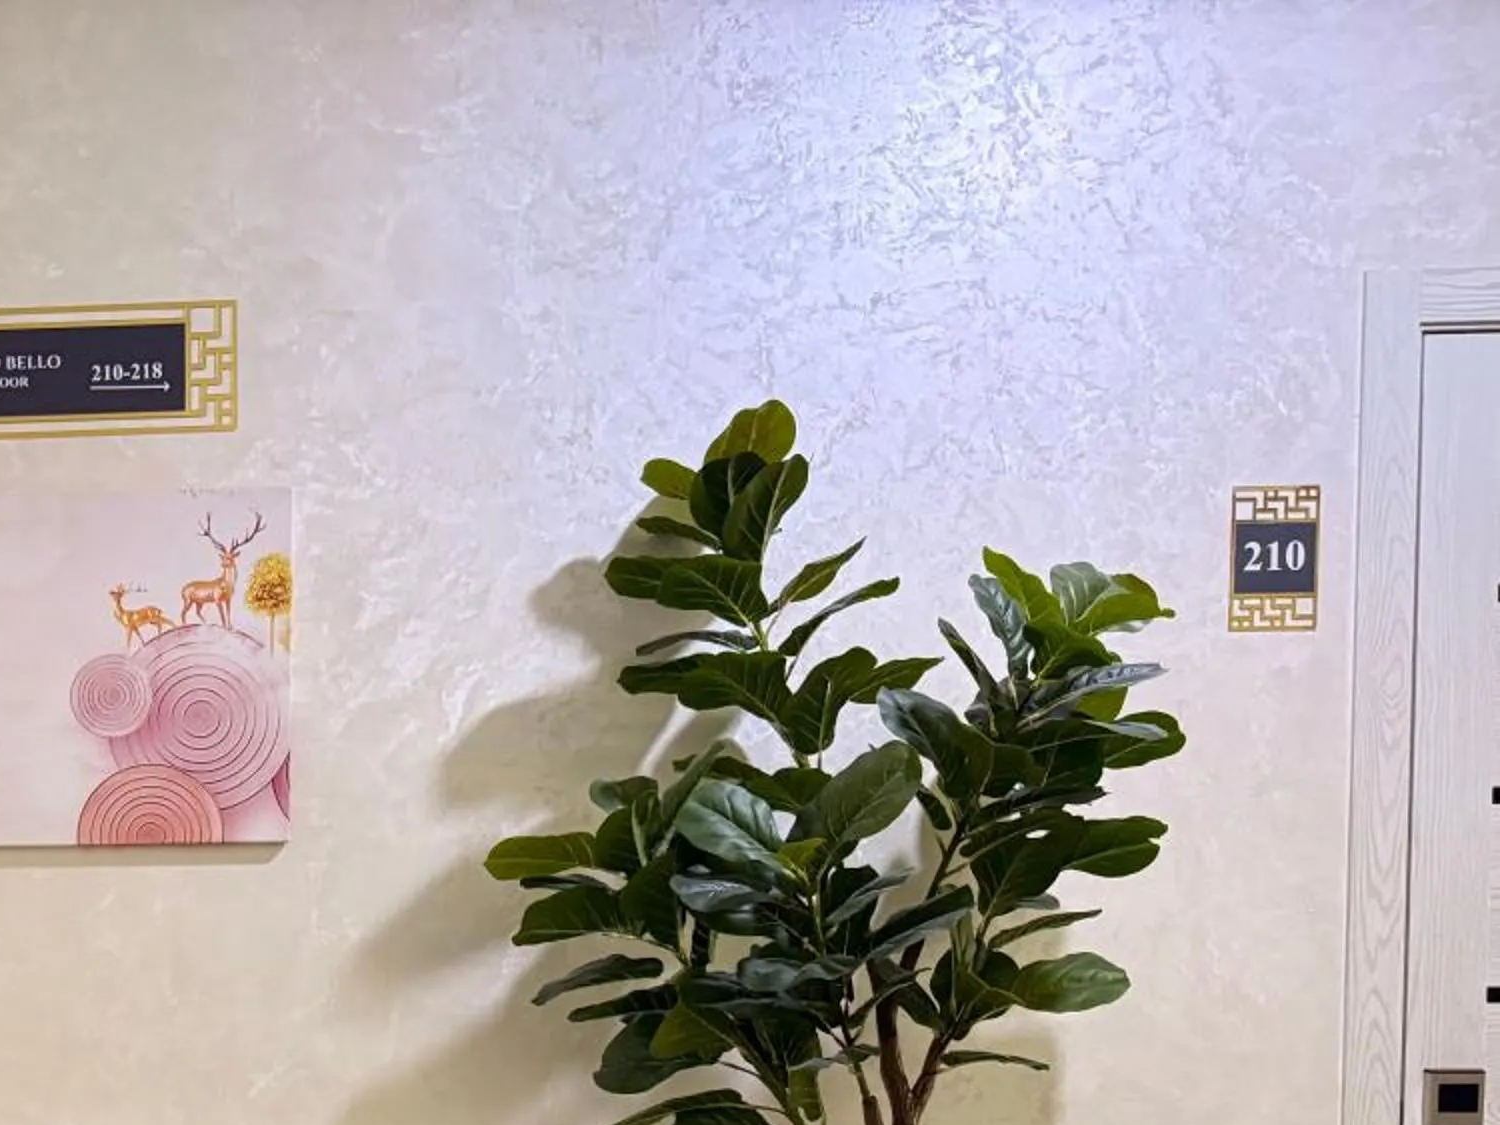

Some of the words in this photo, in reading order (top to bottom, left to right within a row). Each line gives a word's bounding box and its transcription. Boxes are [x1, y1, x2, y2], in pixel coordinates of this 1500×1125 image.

[6, 354, 62, 371] BELLO
[91, 363, 164, 382] 210-218
[1243, 539, 1306, 571] 210
